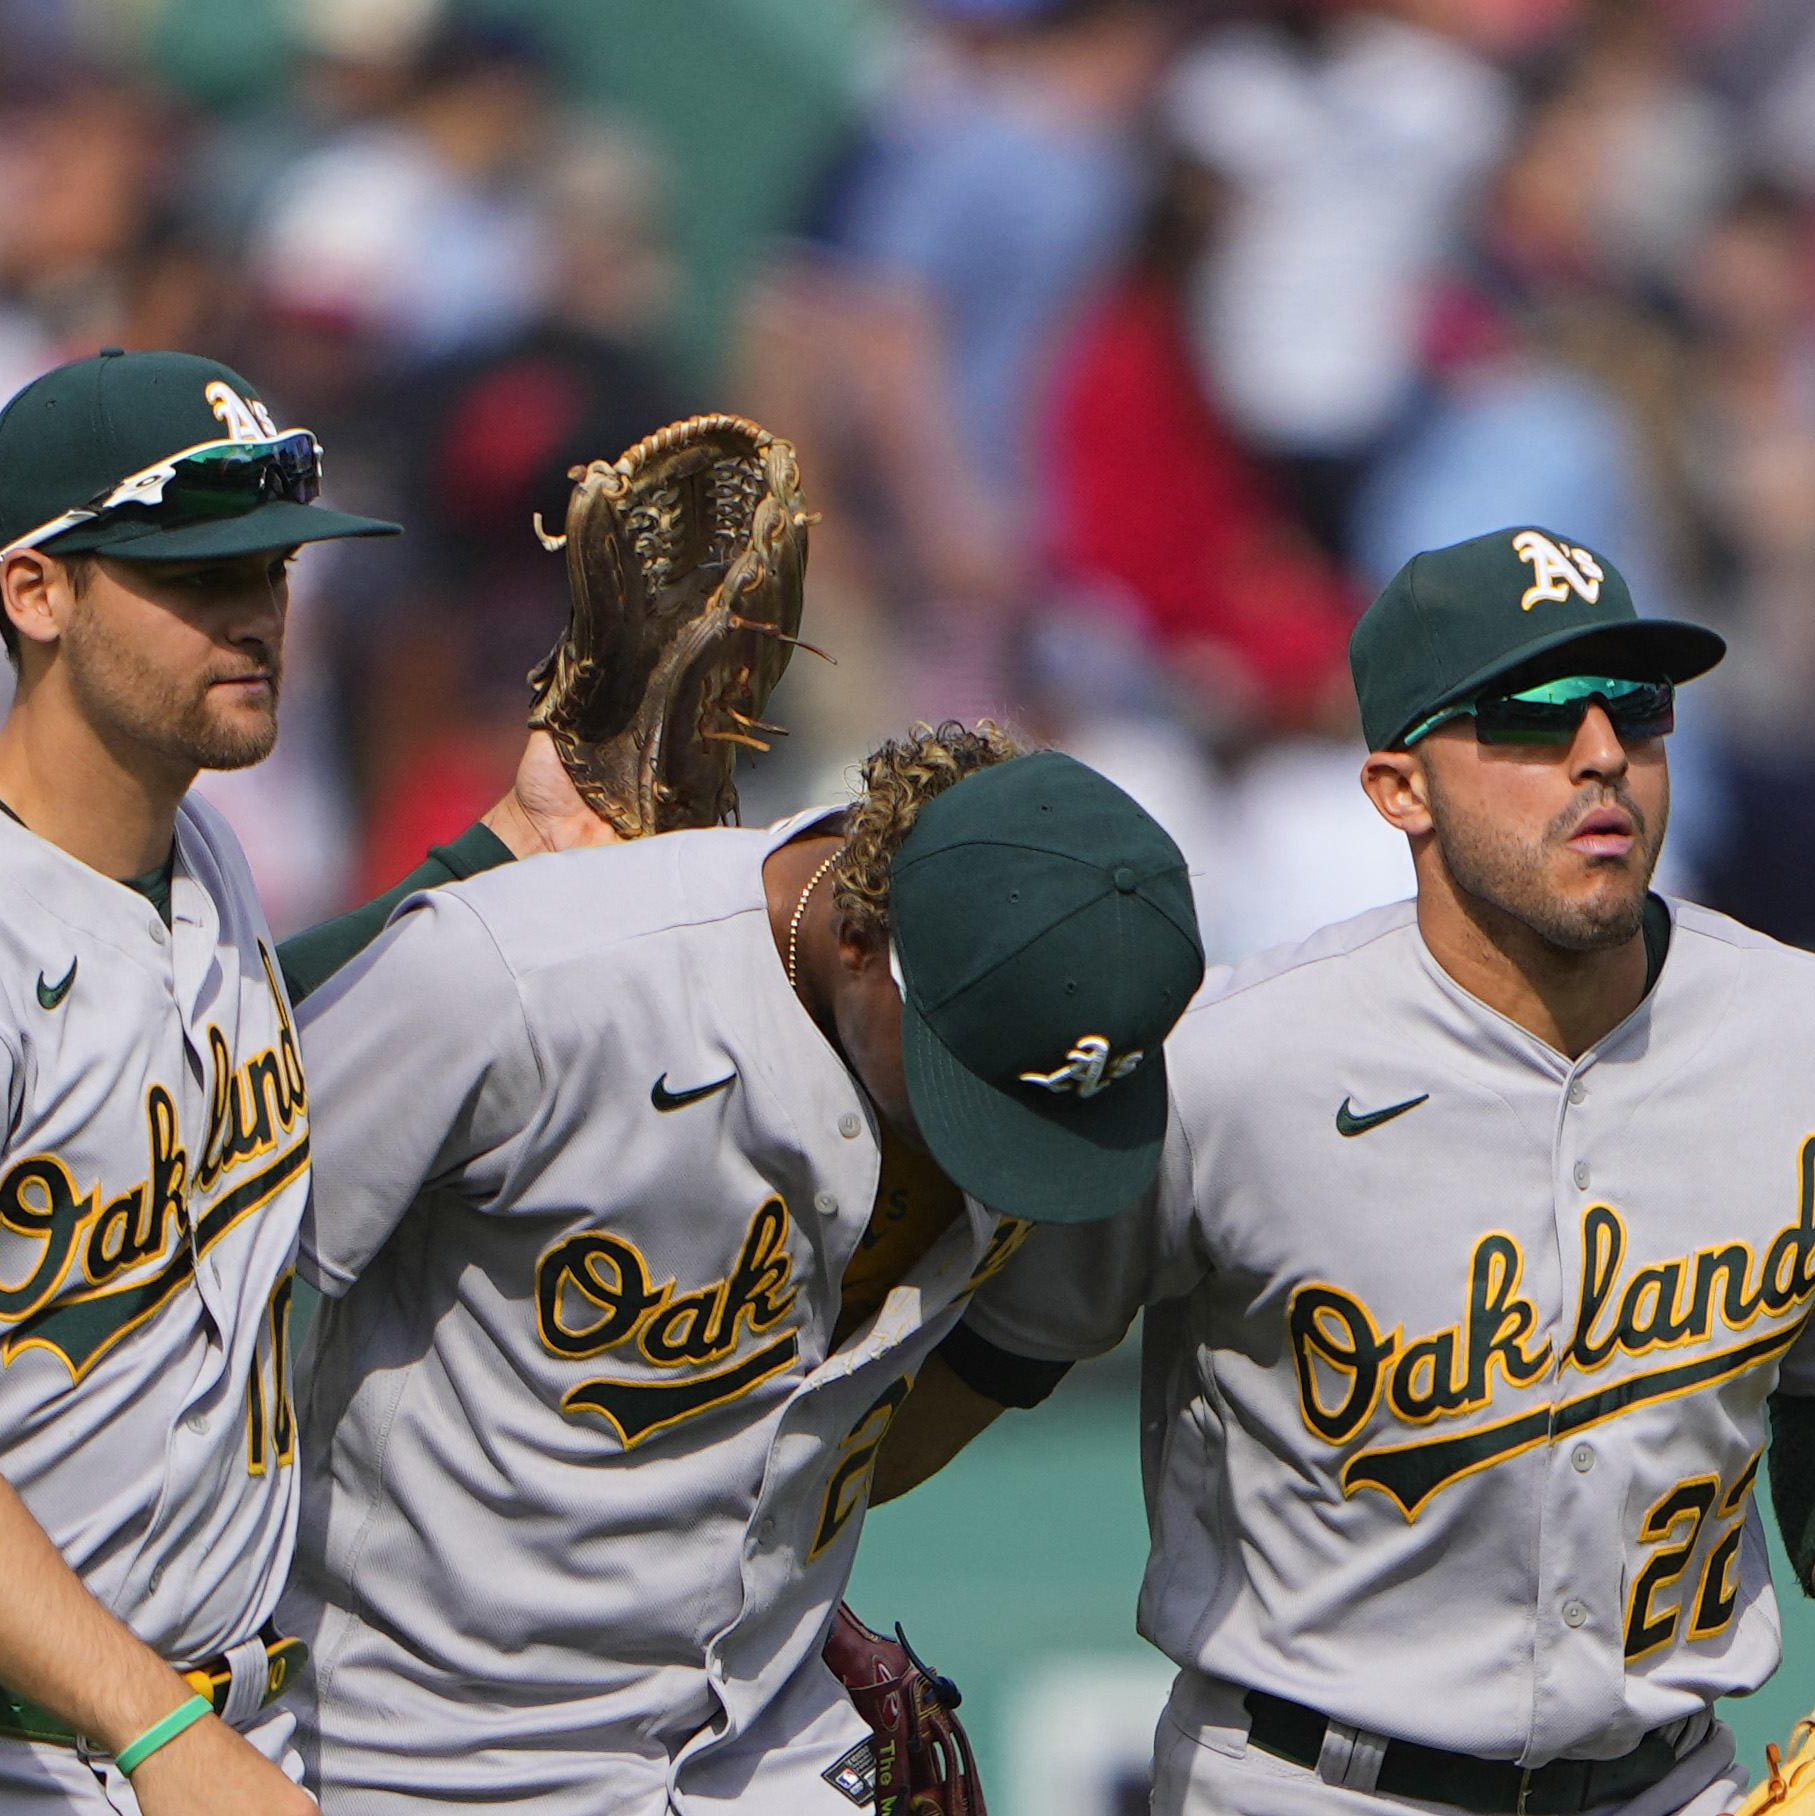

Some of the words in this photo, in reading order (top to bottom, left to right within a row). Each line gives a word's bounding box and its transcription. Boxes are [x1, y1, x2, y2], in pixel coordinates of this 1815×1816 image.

[1511, 530, 1605, 612] A's
[806, 1370, 915, 1565] 2
[1623, 1440, 1766, 1666] 22
[880, 1739, 896, 1786] The
